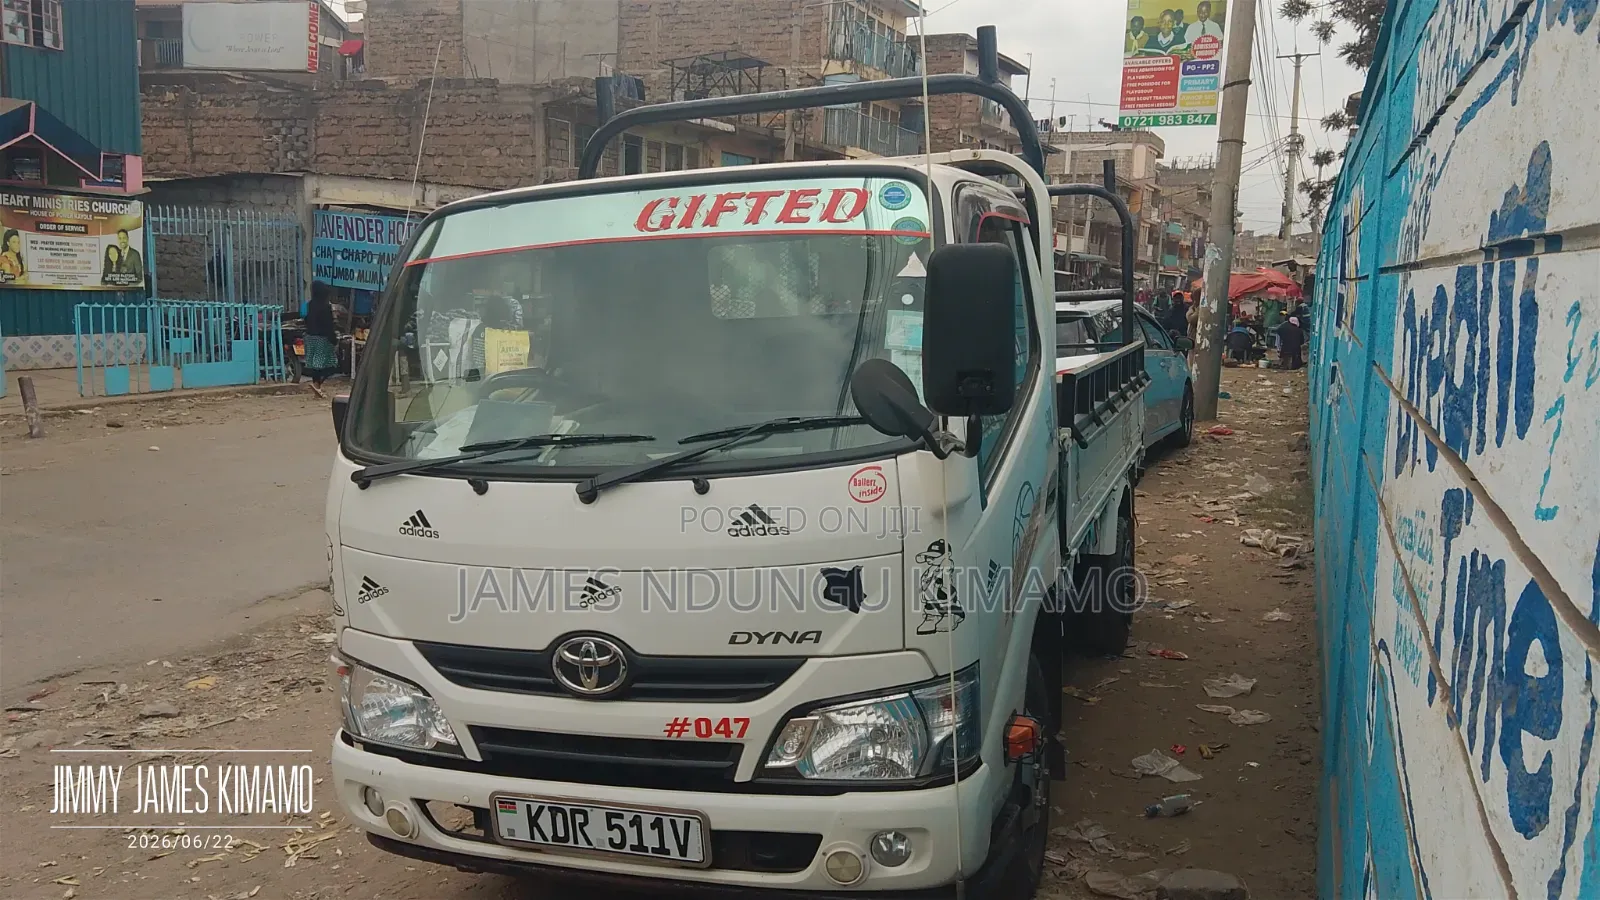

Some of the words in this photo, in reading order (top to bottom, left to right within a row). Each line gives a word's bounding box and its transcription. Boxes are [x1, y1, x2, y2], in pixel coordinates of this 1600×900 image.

[308, 2, 319, 72] WELCOME
[1124, 116, 1154, 127] 0721
[1159, 115, 1182, 125] 983
[1186, 114, 1211, 124] 847
[32, 196, 90, 212] MINISTRIES
[92, 202, 130, 214] CHURCH
[634, 187, 871, 232] GIFTED
[313, 212, 385, 244] LAVENDER
[341, 248, 373, 263] CHAPO
[316, 264, 355, 281] MATUMBO
[853, 477, 877, 487] Ballerz
[858, 485, 883, 498] inside
[398, 525, 440, 539] adidas
[727, 523, 790, 537] adidas
[357, 585, 390, 605] adidas
[579, 584, 622, 609] adidas
[728, 630, 823, 645] DYNA
[663, 717, 750, 738] #047
[526, 803, 594, 847] KDR
[605, 811, 691, 858] 511V
